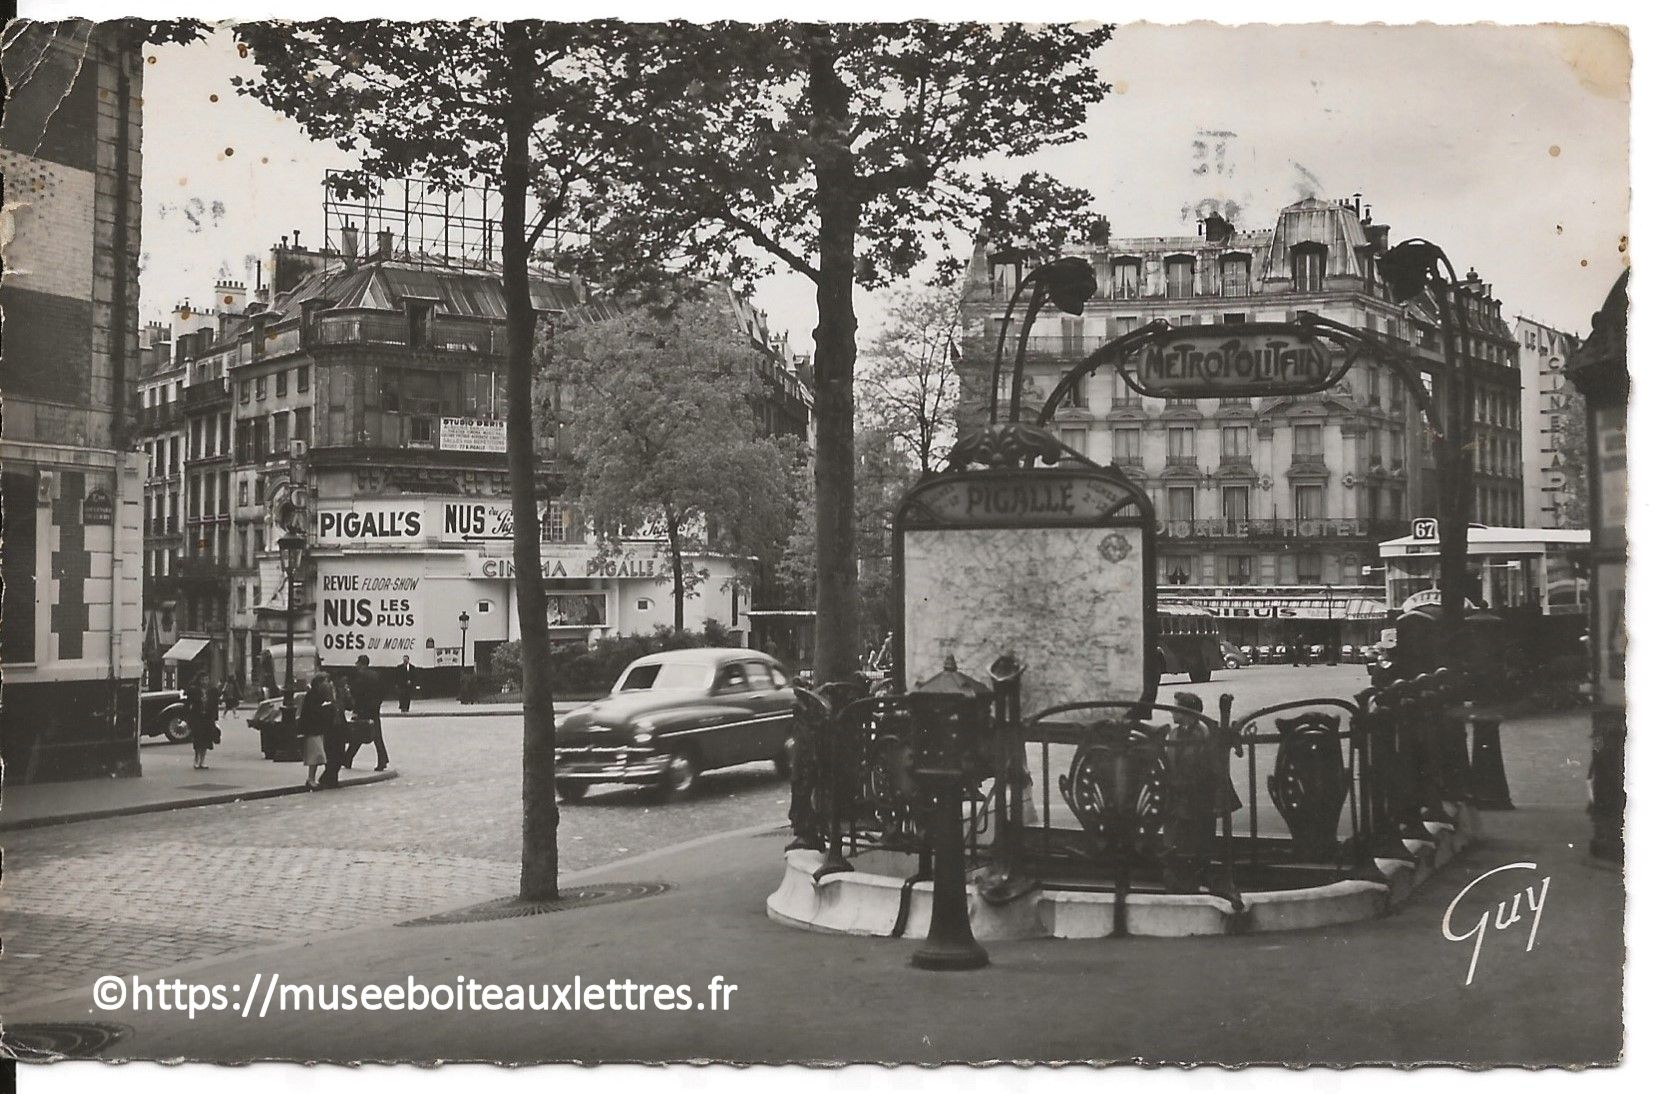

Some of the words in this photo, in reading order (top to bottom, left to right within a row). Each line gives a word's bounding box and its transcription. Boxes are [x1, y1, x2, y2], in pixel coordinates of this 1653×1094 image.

[1145, 338, 1325, 383] METROPOLITAIN
[966, 481, 1076, 516] PIGALLE
[320, 511, 421, 538] PIGALL'S
[445, 504, 485, 534] NUS
[1415, 521, 1435, 539] 67
[586, 559, 654, 577] PIGALLE
[323, 575, 359, 591] REVUE
[361, 577, 420, 591] FLOOR-SHOW
[323, 598, 373, 627] NUS
[380, 599, 410, 612] LES
[376, 614, 415, 627] PLUS
[323, 631, 366, 650] OSÉS
[367, 638, 381, 650] DU
[382, 637, 416, 650] MONDE
